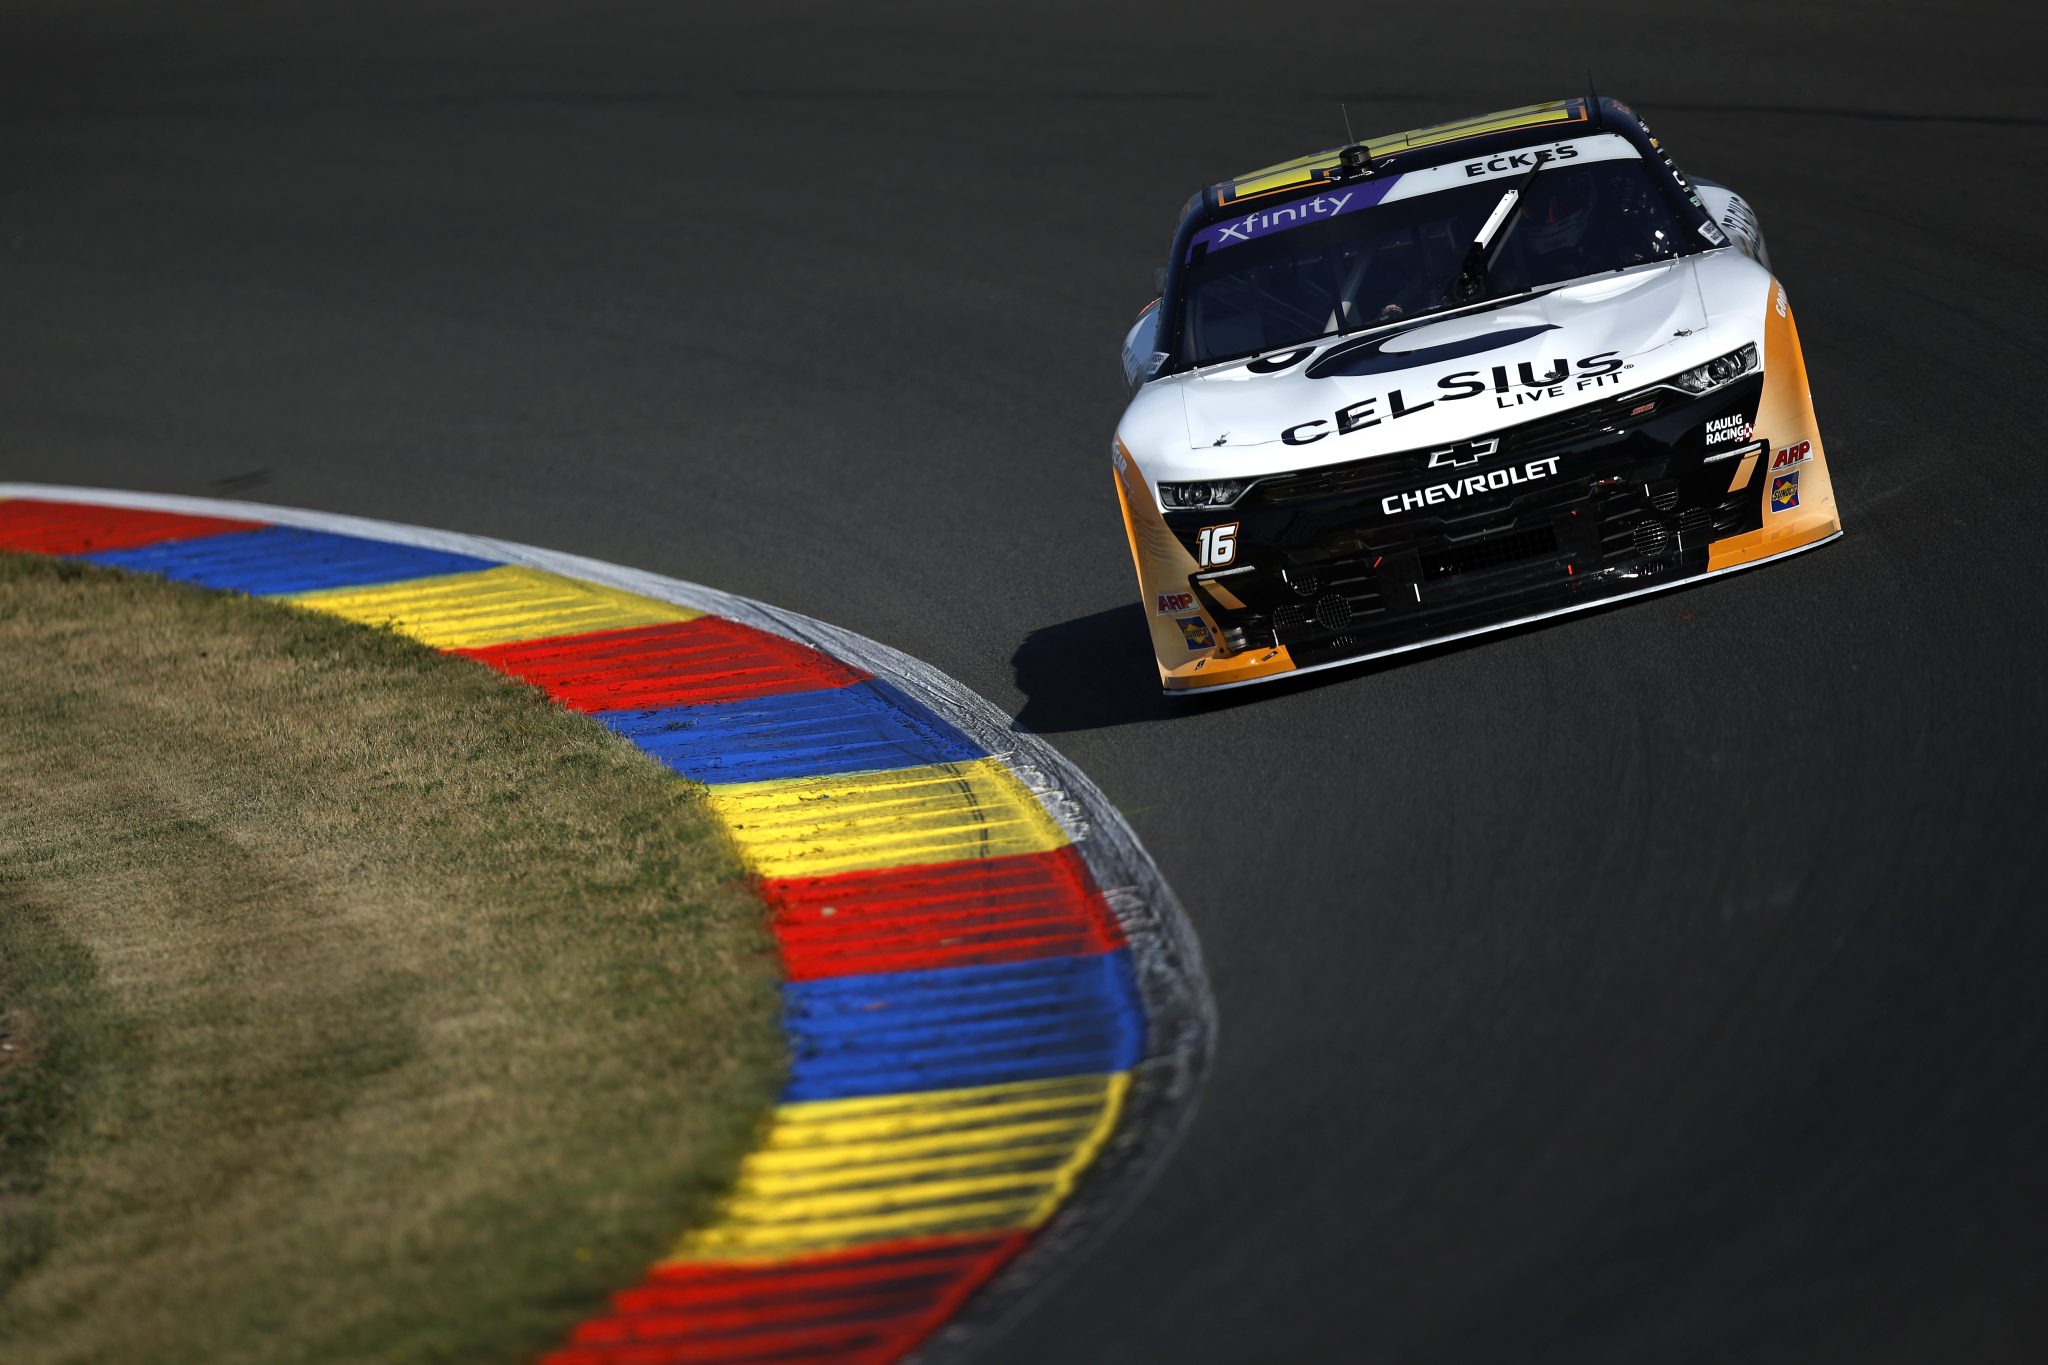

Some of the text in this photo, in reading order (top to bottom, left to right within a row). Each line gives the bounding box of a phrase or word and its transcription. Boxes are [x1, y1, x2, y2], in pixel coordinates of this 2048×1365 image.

[1465, 145, 1579, 178] ECKES
[1218, 192, 1354, 243] xfinity
[1496, 371, 1623, 408] LIVE FIT
[1706, 413, 1743, 433] KAULIG
[1706, 425, 1744, 446] RACING
[1773, 440, 1811, 468] ARP
[1382, 456, 1560, 515] CHEVROLET
[1198, 523, 1238, 568] 16
[1158, 593, 1194, 612] ARP
